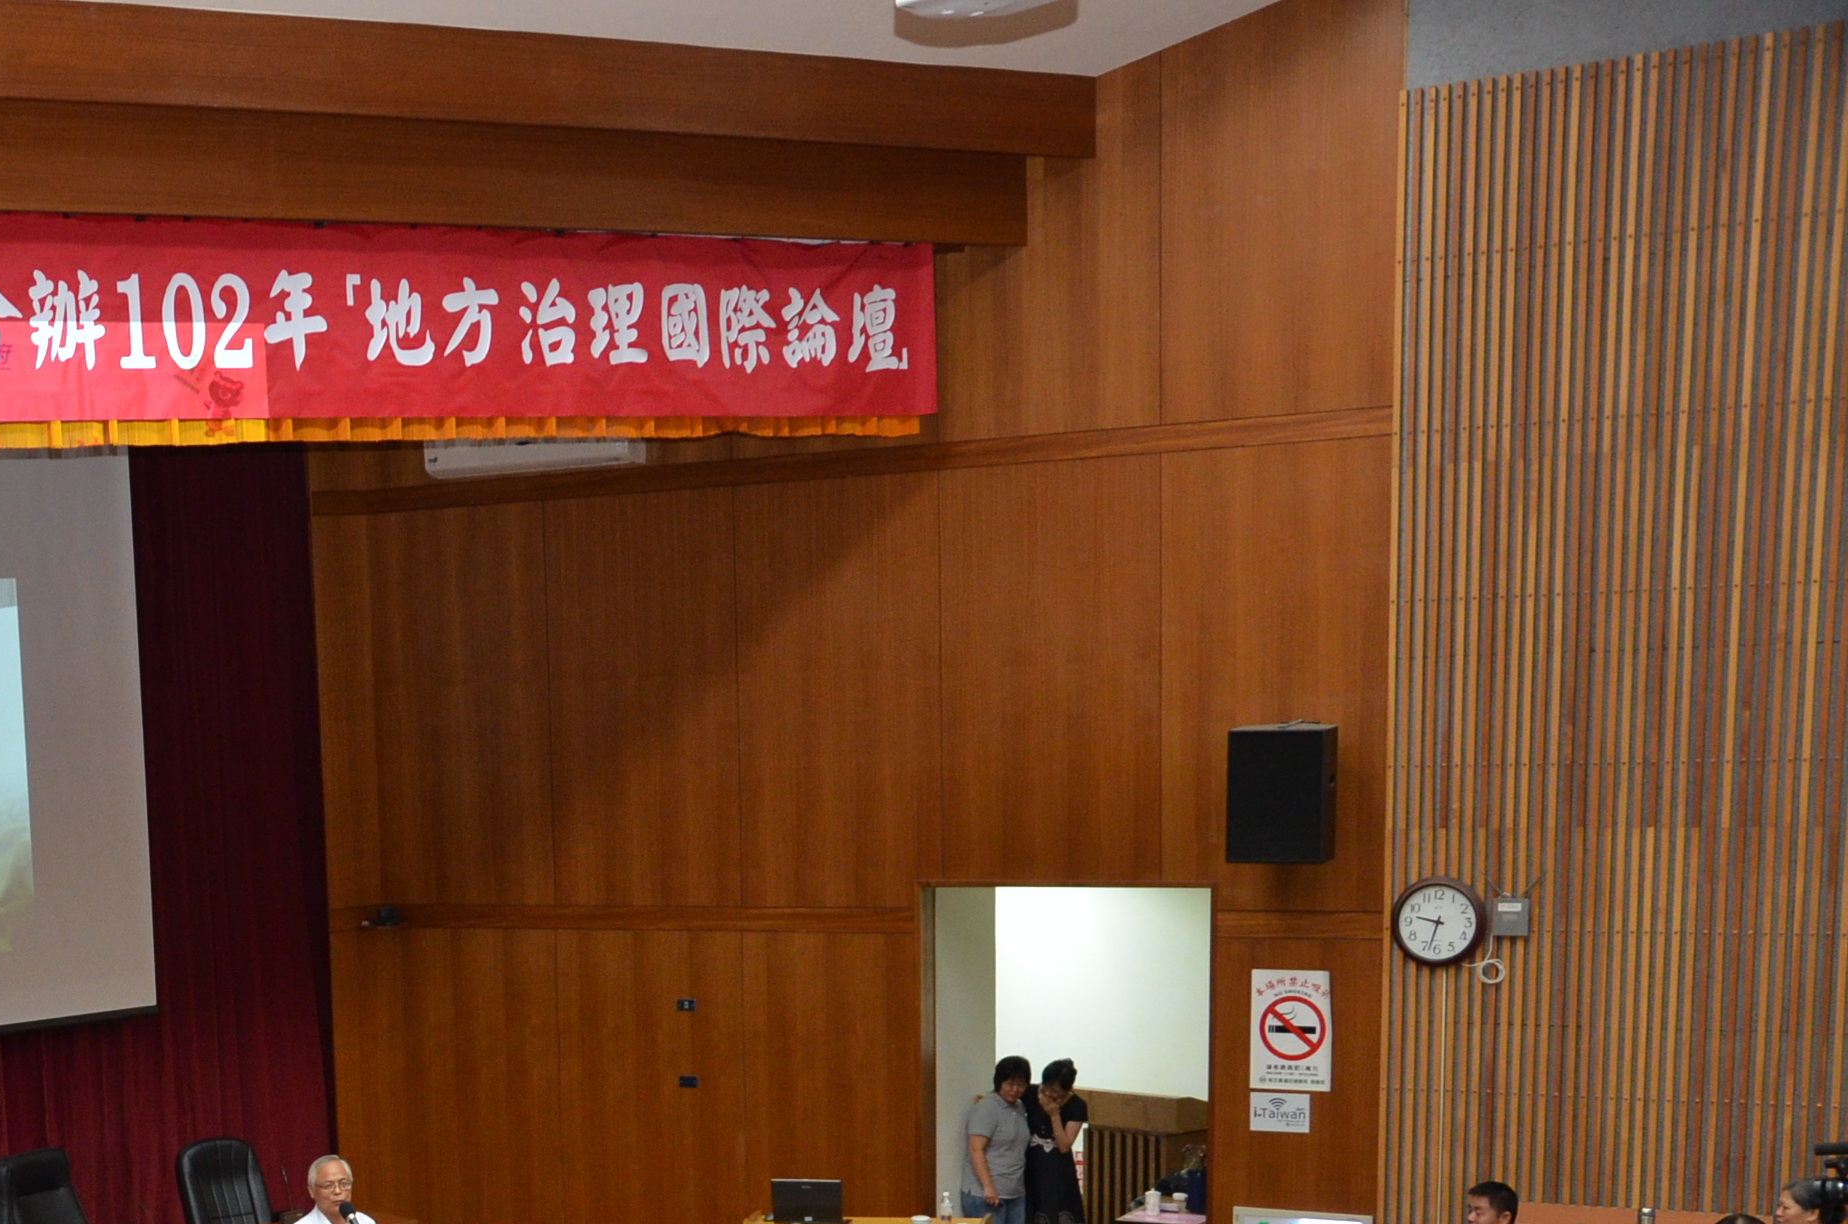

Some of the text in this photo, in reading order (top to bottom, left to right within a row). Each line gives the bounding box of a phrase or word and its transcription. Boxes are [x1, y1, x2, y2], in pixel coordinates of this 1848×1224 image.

[1423, 893, 1431, 903] 11
[1435, 889, 1445, 900] 12
[1410, 903, 1421, 914] 10
[1460, 903, 1469, 914] 2
[1404, 916, 1412, 927] 9
[1464, 918, 1472, 928] 3
[1408, 931, 1417, 941] 8
[1459, 931, 1467, 941] 4
[1421, 941, 1429, 951] 7
[1433, 944, 1441, 955] 6
[1447, 942, 1455, 952] 5
